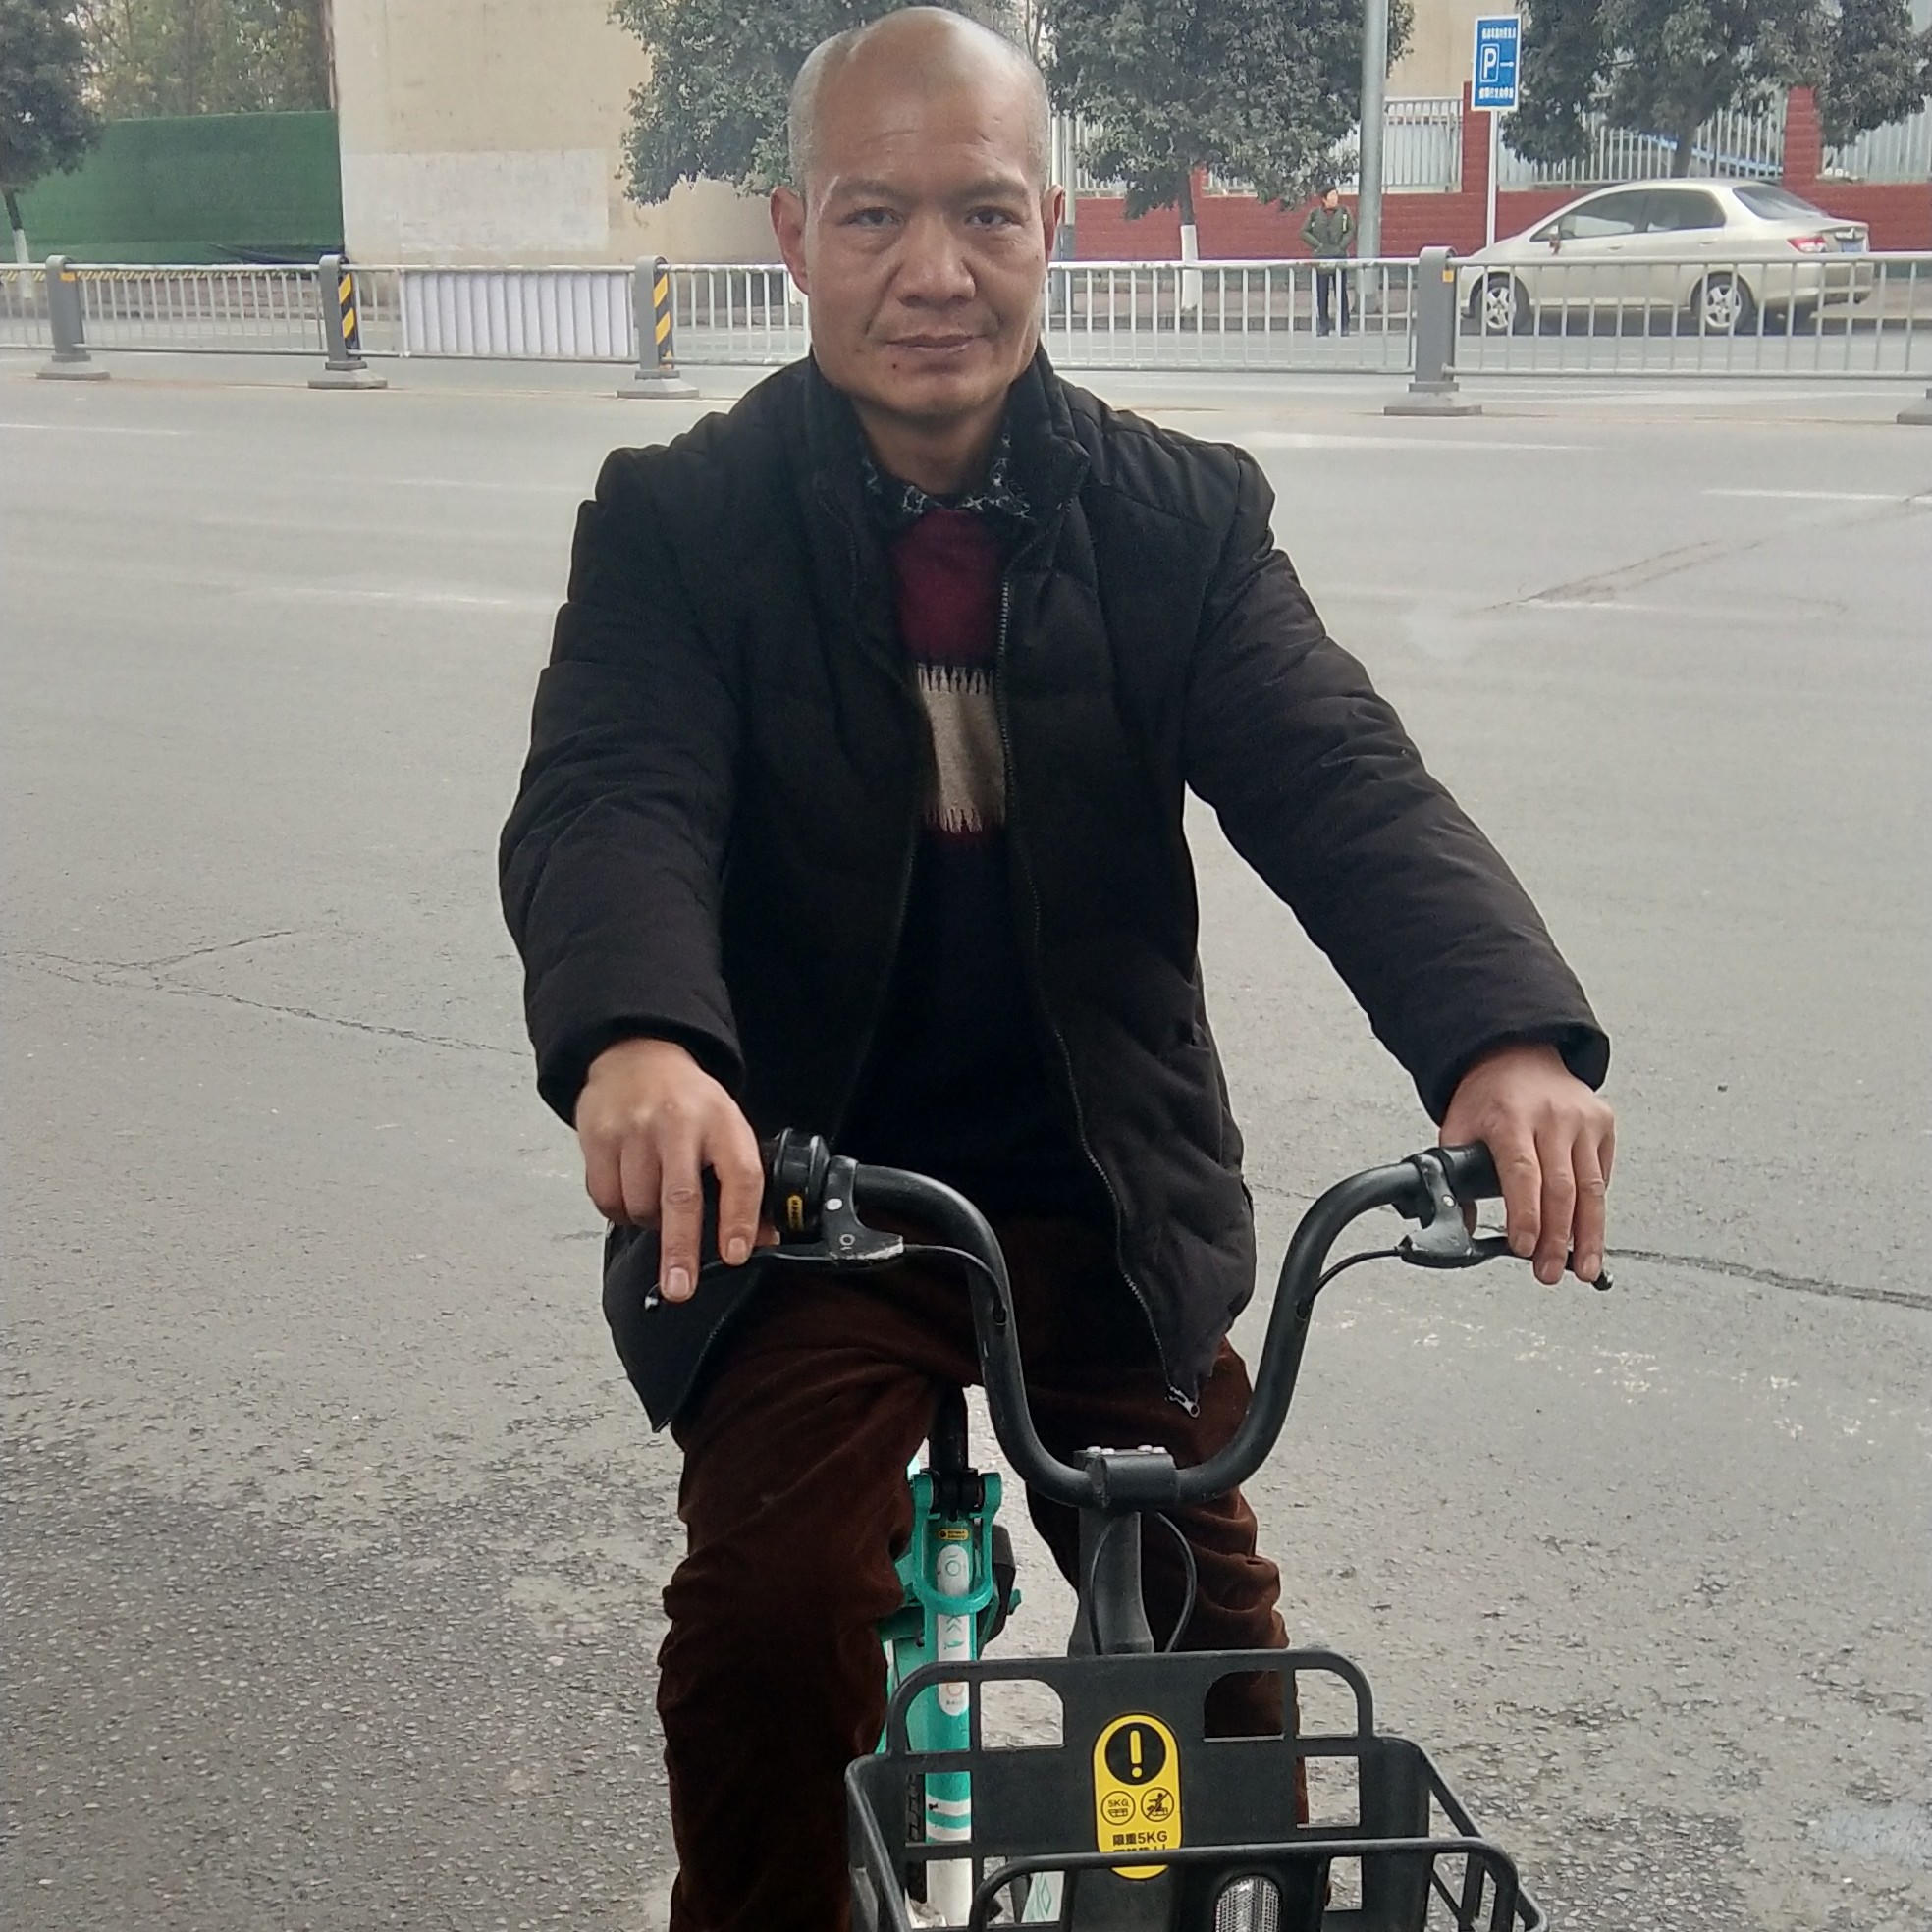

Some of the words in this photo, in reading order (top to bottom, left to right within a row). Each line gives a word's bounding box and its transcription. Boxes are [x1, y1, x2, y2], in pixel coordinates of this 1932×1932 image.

[1483, 47, 1497, 79] P
[1108, 1798, 1129, 1807] 5KG
[1113, 1830, 1168, 1846] 限重5KG
